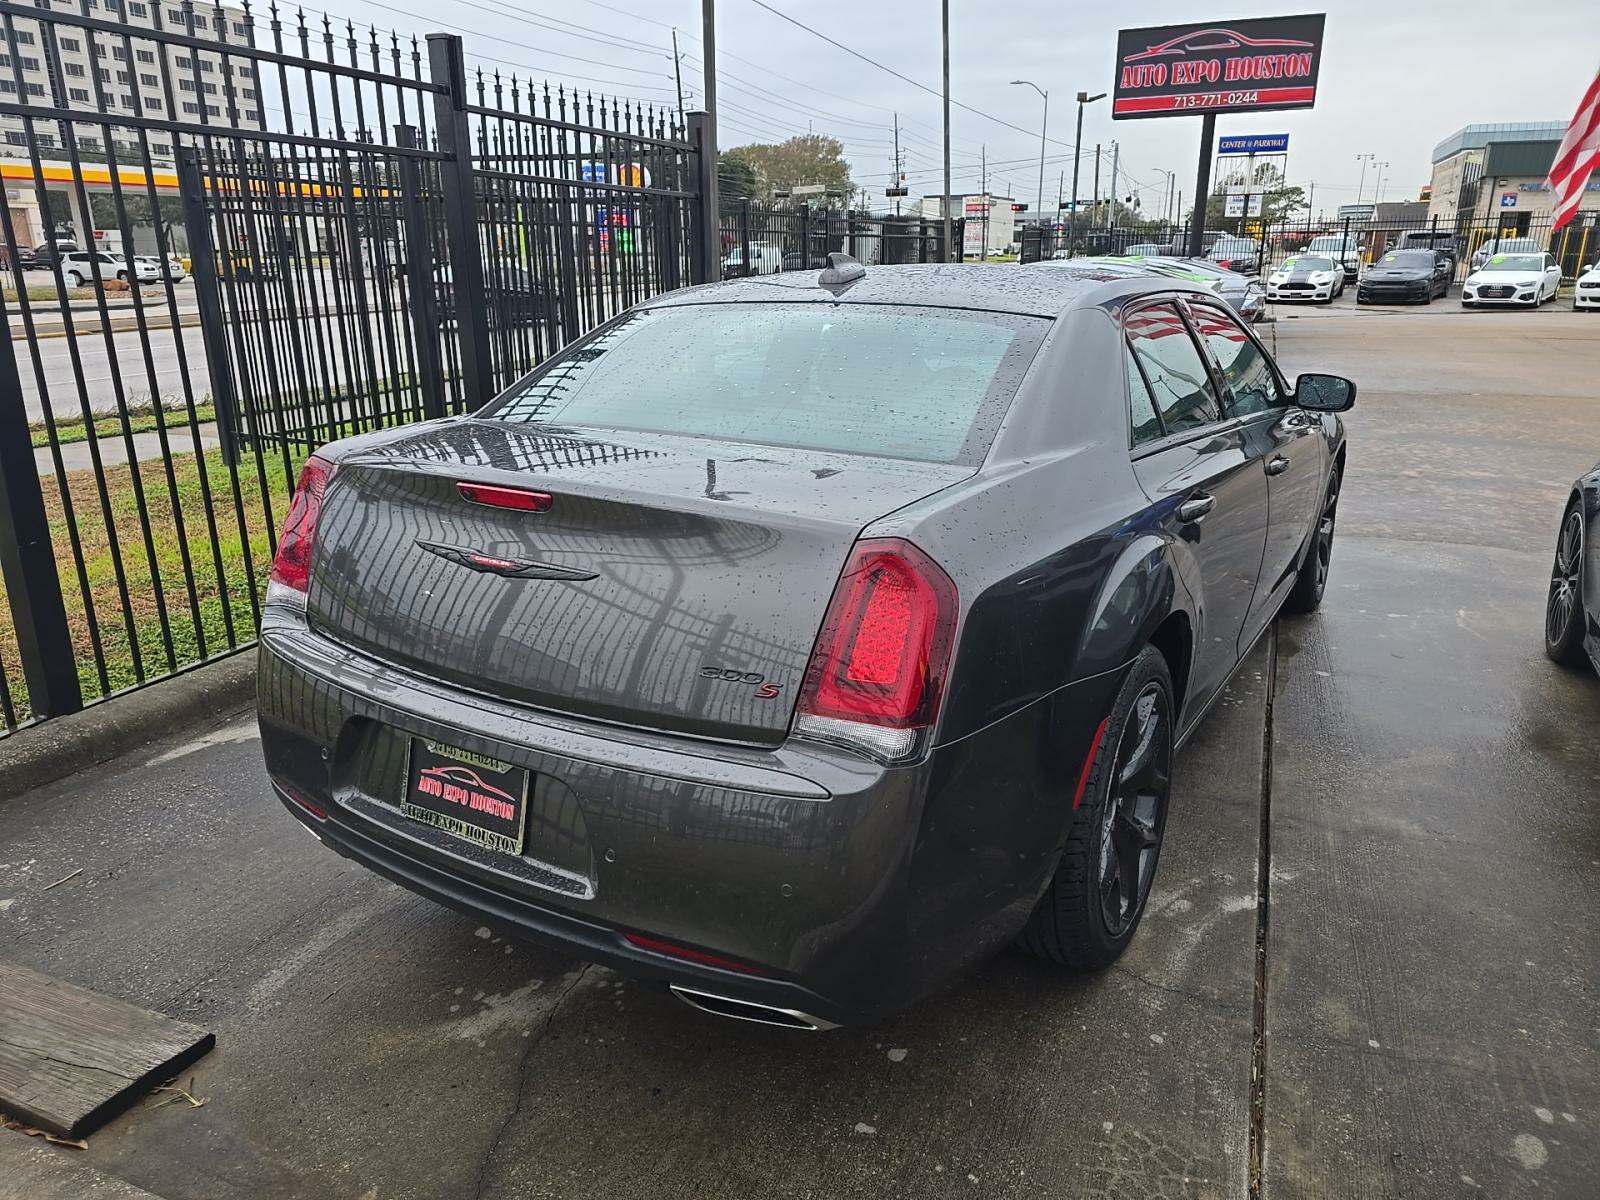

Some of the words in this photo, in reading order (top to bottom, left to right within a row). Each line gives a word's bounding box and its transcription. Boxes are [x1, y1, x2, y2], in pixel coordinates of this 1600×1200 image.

[1120, 63, 1167, 88] AUTO
[1171, 59, 1220, 84] EXPO
[1224, 53, 1313, 81] HOUSTON
[1174, 92, 1258, 108] 713-771-0244
[1221, 140, 1246, 149] CENTER
[1253, 139, 1285, 148] PARKWAY
[700, 666, 765, 684] 300
[418, 776, 442, 797] AUTO
[443, 783, 469, 805] EXPO
[470, 792, 515, 820] HOUSTON
[434, 813, 463, 833] EXPO
[465, 823, 517, 853] HOUSTON
